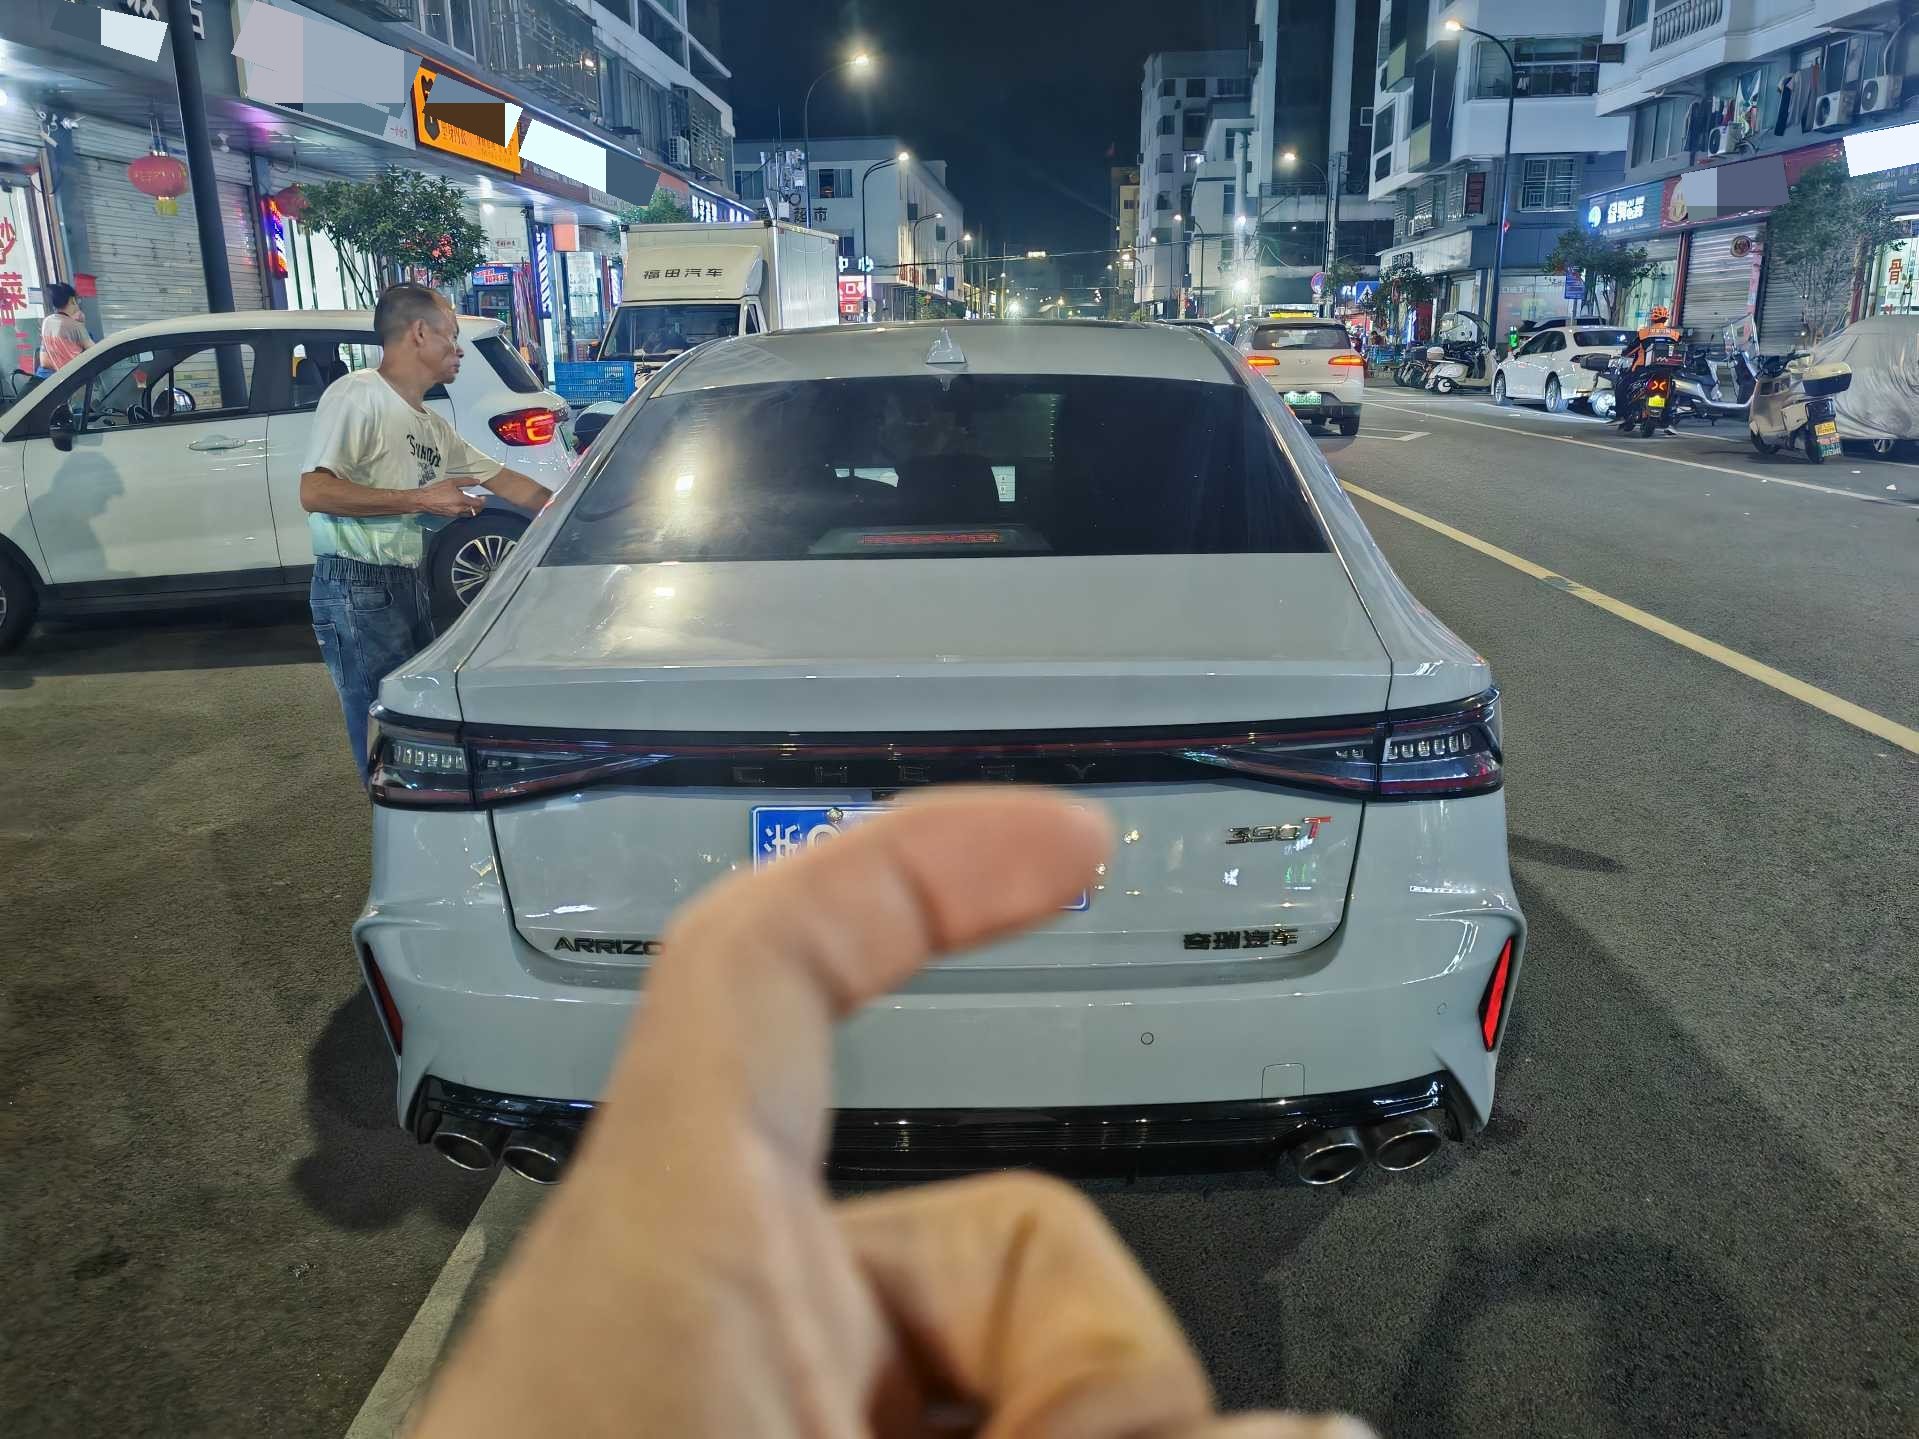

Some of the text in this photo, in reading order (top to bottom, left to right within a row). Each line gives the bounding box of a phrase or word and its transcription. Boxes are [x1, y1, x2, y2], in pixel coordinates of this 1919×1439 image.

[643, 267, 723, 280] 福田汽车
[1889, 259, 1902, 285] 骨
[1184, 928, 1298, 951] 奇瑞汽车
